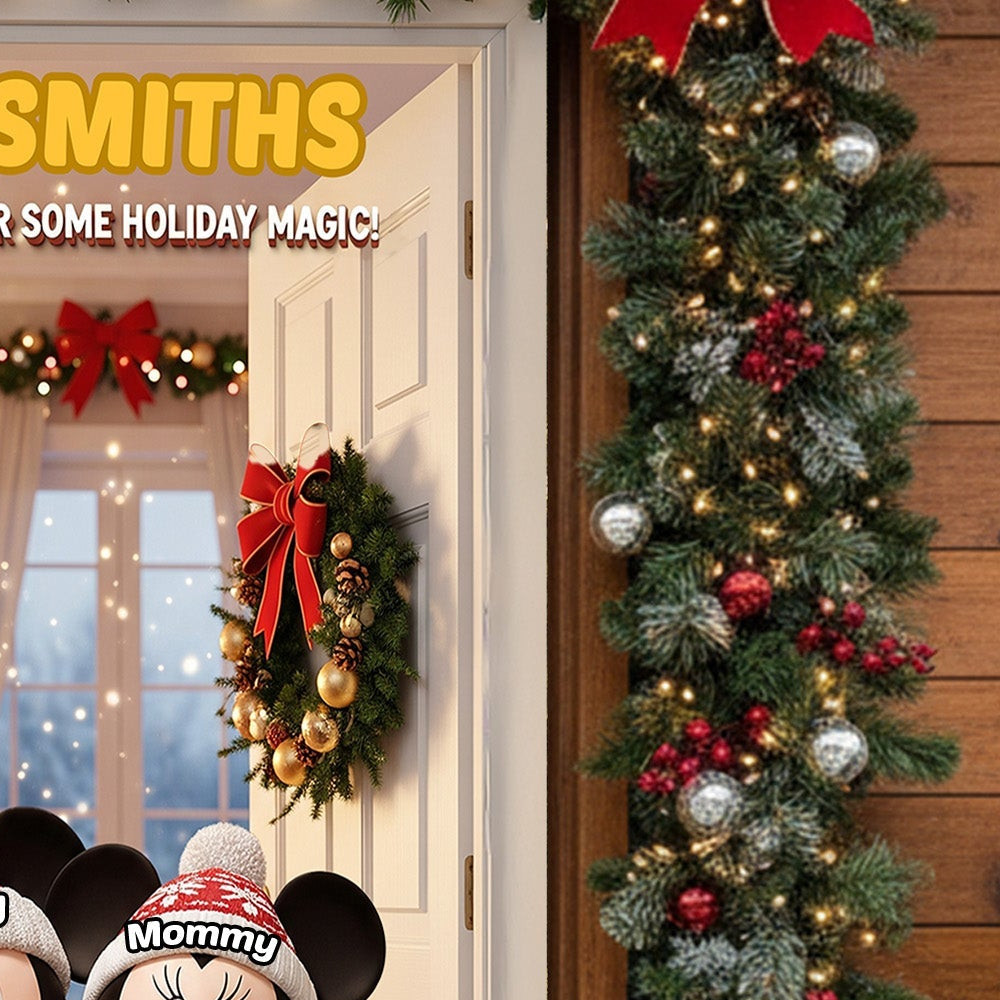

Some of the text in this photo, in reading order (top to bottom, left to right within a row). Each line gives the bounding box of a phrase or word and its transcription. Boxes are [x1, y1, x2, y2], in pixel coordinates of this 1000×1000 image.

[21, 202, 115, 242] SOME
[123, 202, 256, 242] HOLIDAY
[267, 203, 380, 242] MAGIC!
[126, 920, 280, 963] Mommy
